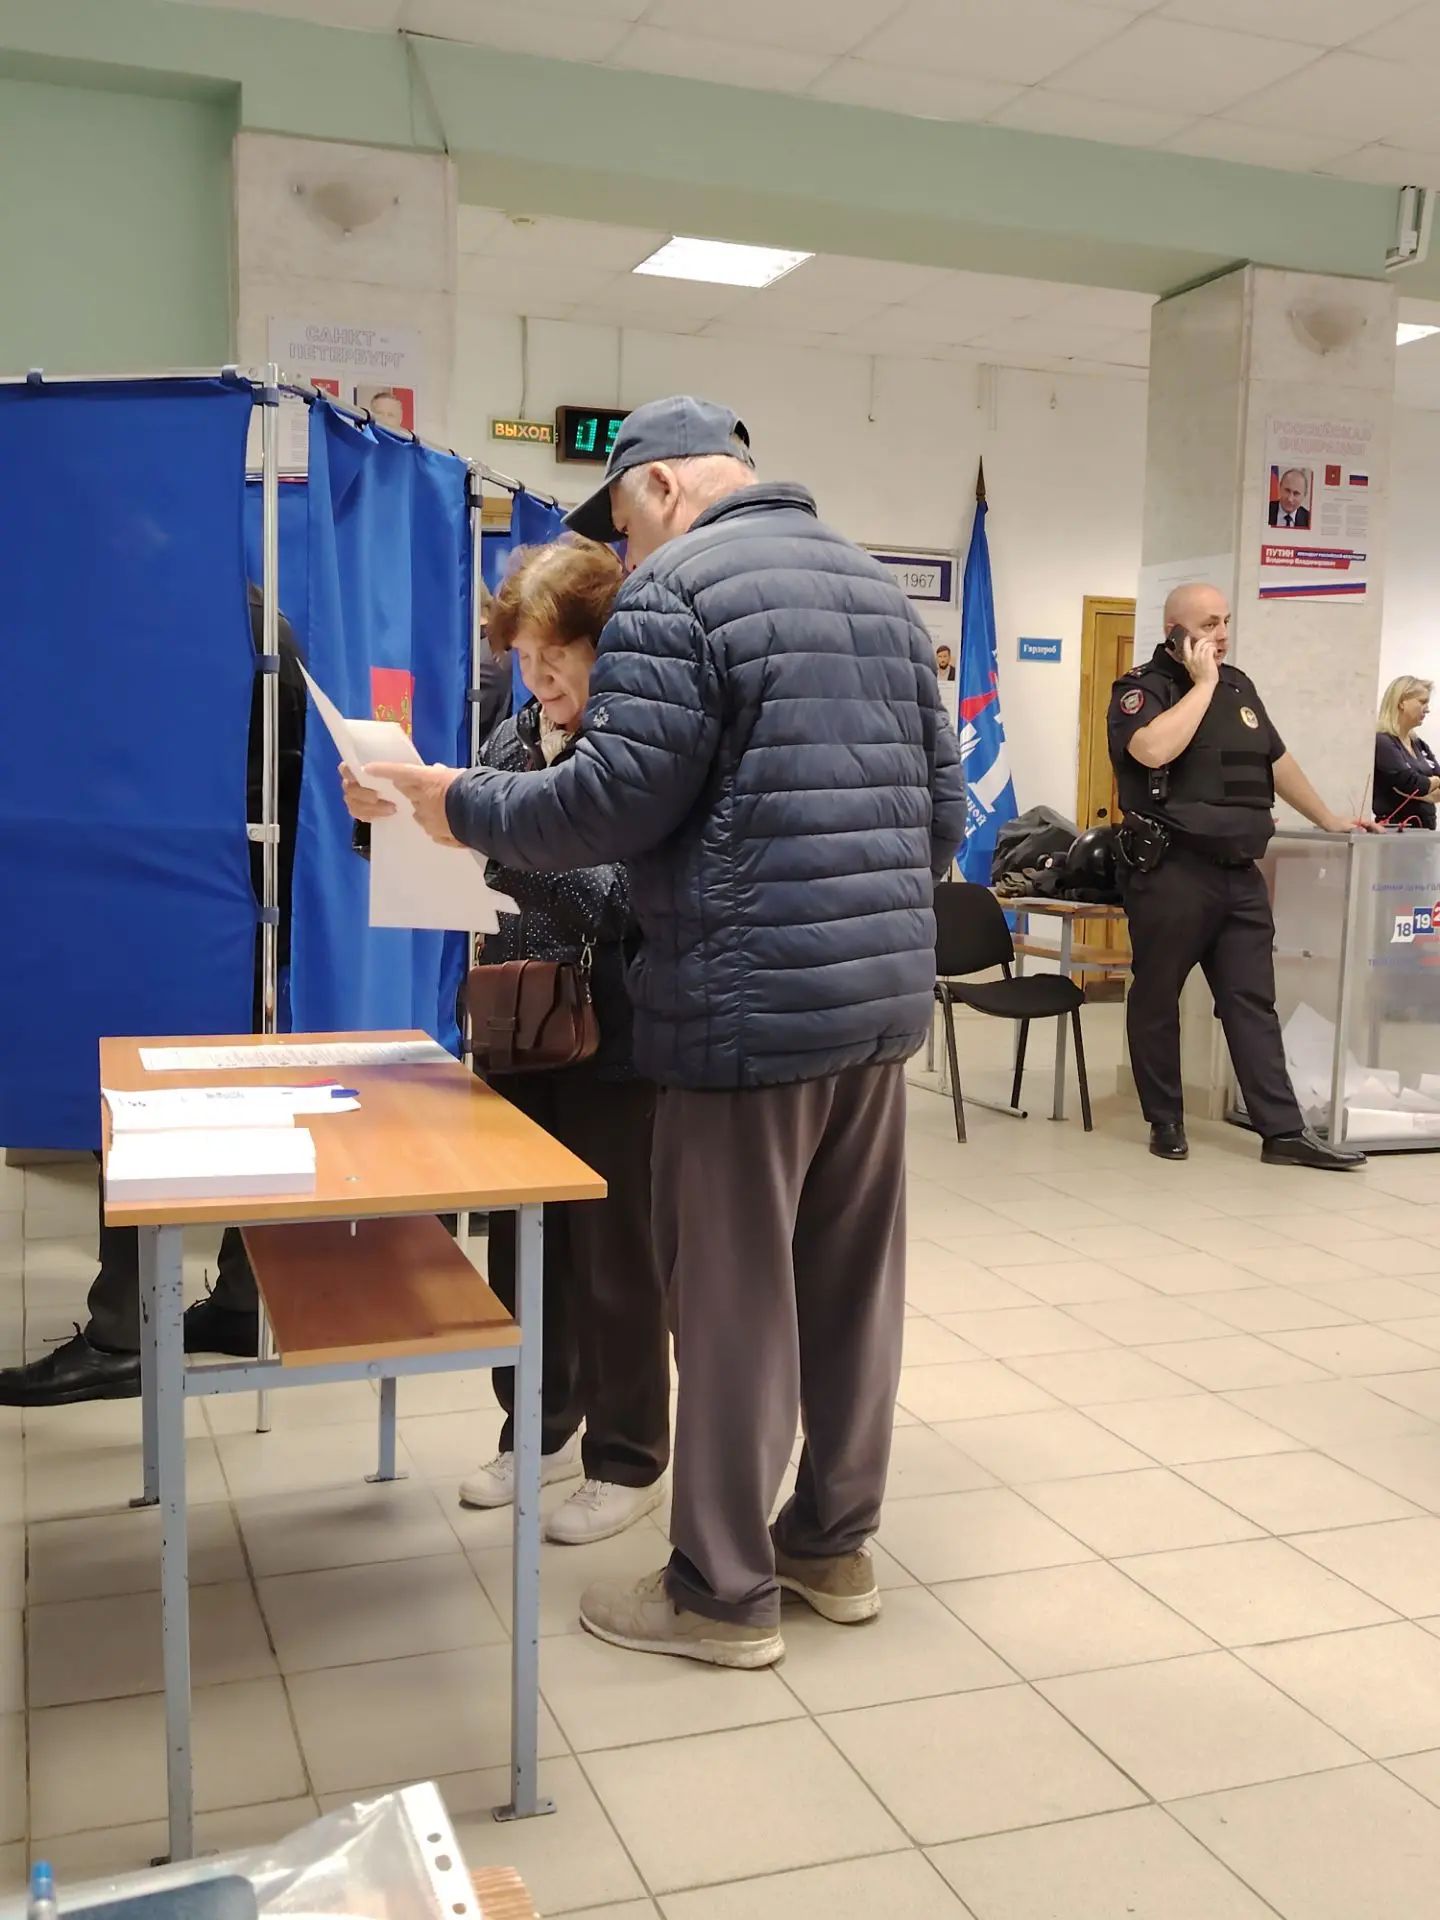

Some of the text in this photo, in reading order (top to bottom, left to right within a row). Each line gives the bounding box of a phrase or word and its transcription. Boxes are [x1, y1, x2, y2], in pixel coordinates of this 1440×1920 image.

[288, 341, 407, 369] ПЕТЕРБУРГ
[495, 423, 550, 442] ВЫХОД
[1266, 549, 1294, 558] ПУТИН
[903, 572, 936, 590] 1967
[1023, 643, 1057, 656] Гардероб
[1415, 913, 1432, 929] 19
[1397, 922, 1412, 937] 18
